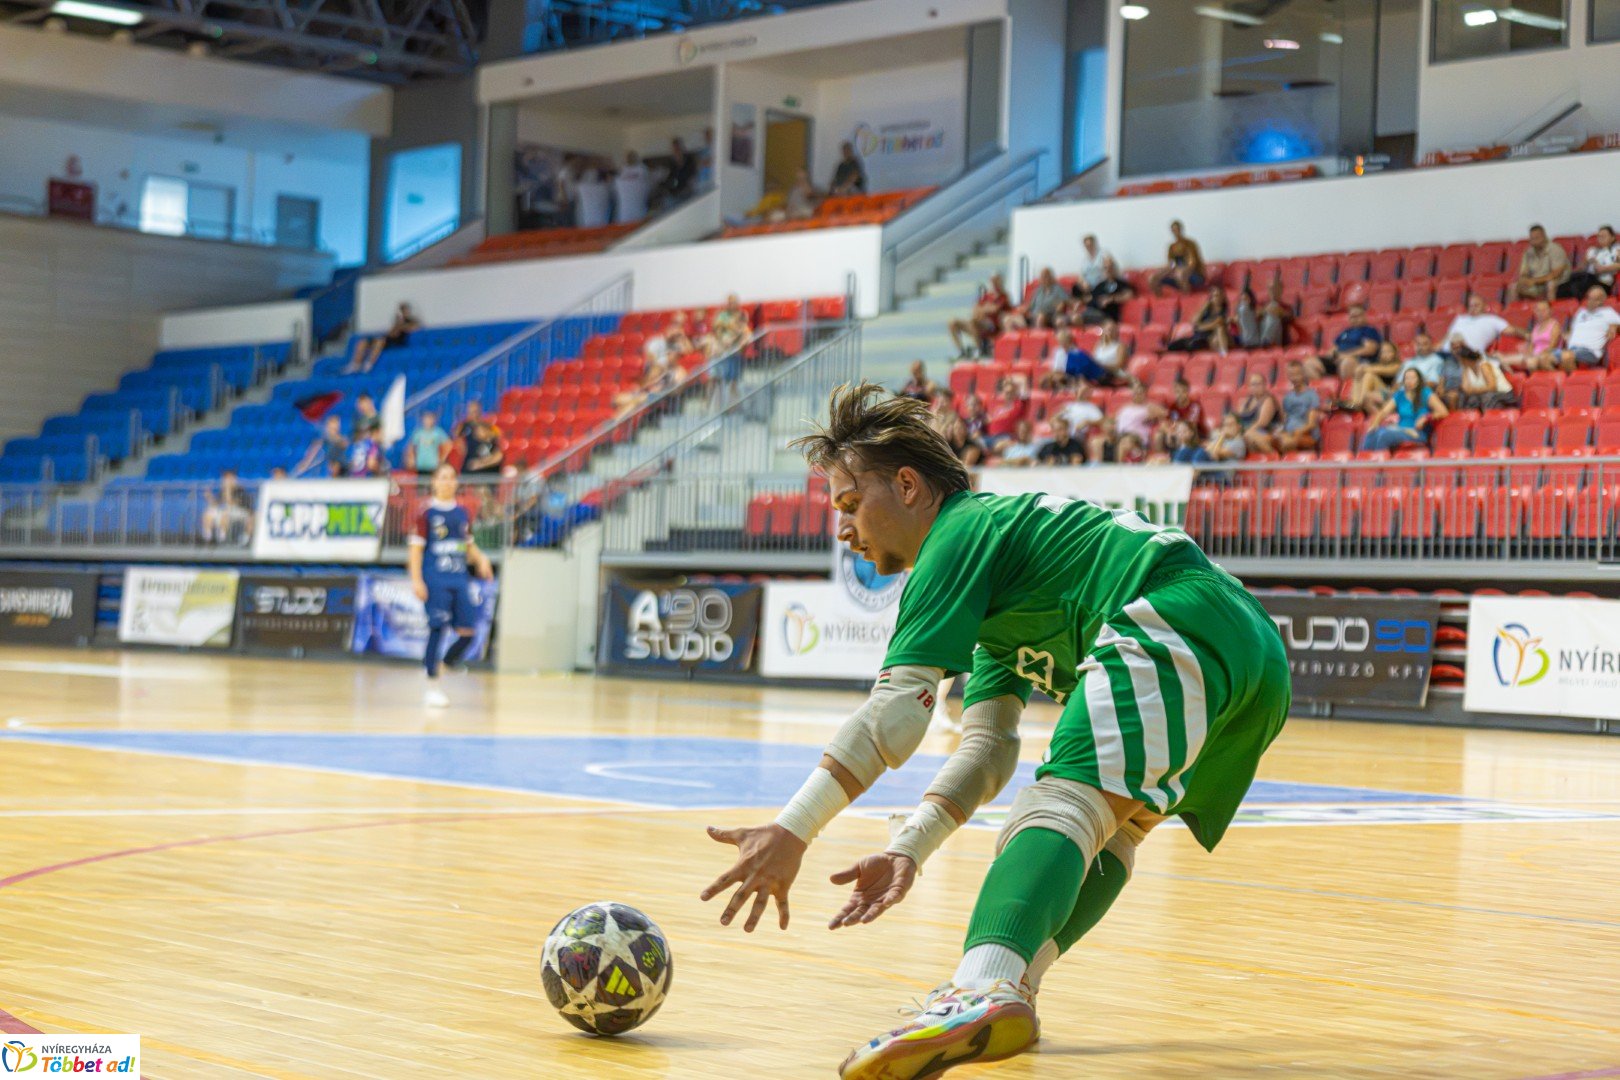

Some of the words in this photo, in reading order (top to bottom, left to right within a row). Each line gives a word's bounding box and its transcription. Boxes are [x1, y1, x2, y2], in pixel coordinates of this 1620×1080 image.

[825, 619, 896, 641] NYÍREGY
[1270, 615, 1370, 652] TUDIO
[1374, 618, 1433, 653] 90
[623, 630, 733, 662] STUDIO
[1560, 644, 1620, 673] NYÍR
